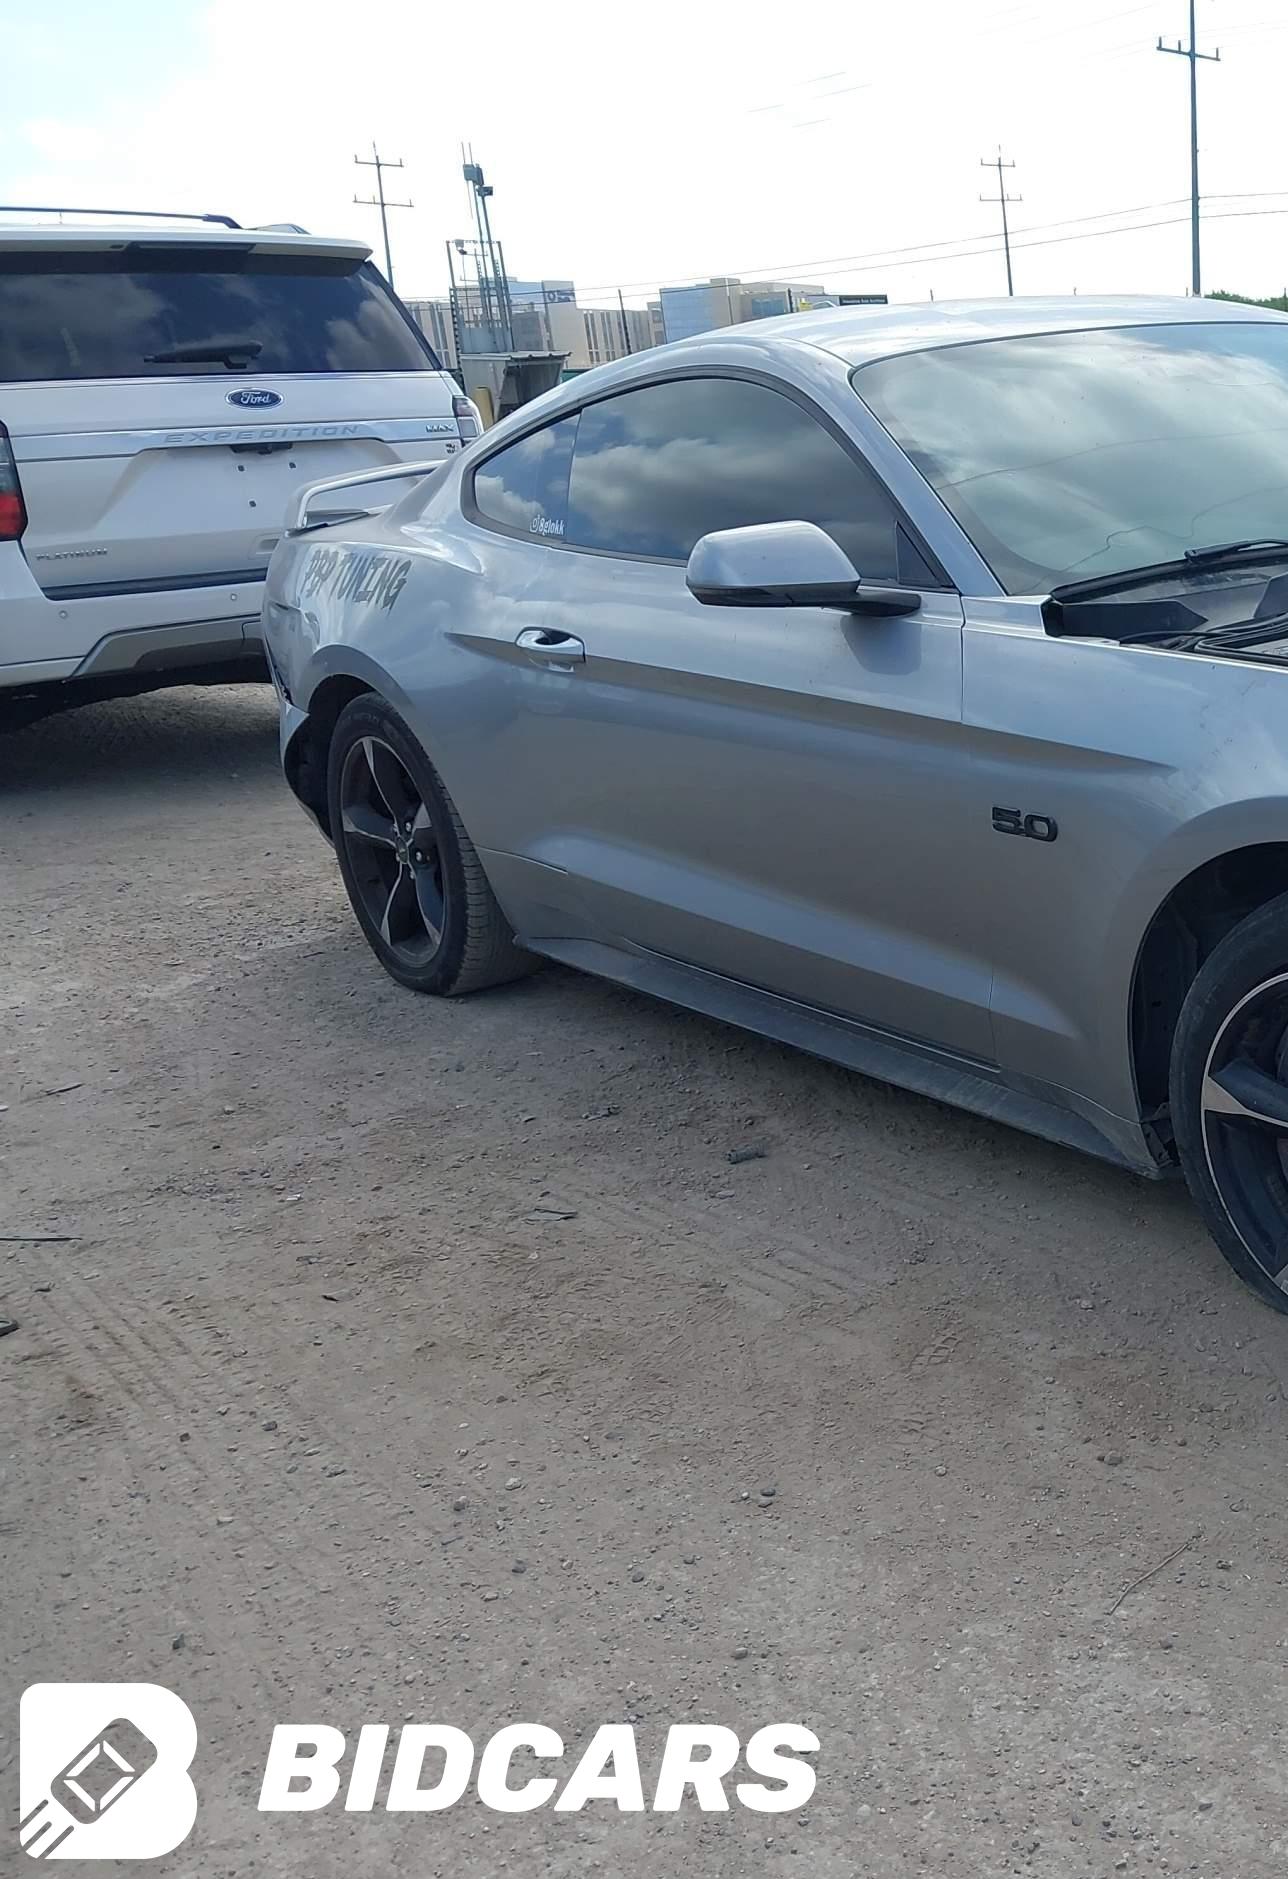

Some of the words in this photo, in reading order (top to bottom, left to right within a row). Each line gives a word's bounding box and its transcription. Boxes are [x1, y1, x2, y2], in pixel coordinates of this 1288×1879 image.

[240, 391, 271, 404] Ford
[164, 424, 359, 444] EXPEDITION
[425, 424, 455, 433] MAX
[36, 548, 108, 561] PLATINUM
[328, 552, 412, 612] TUNING
